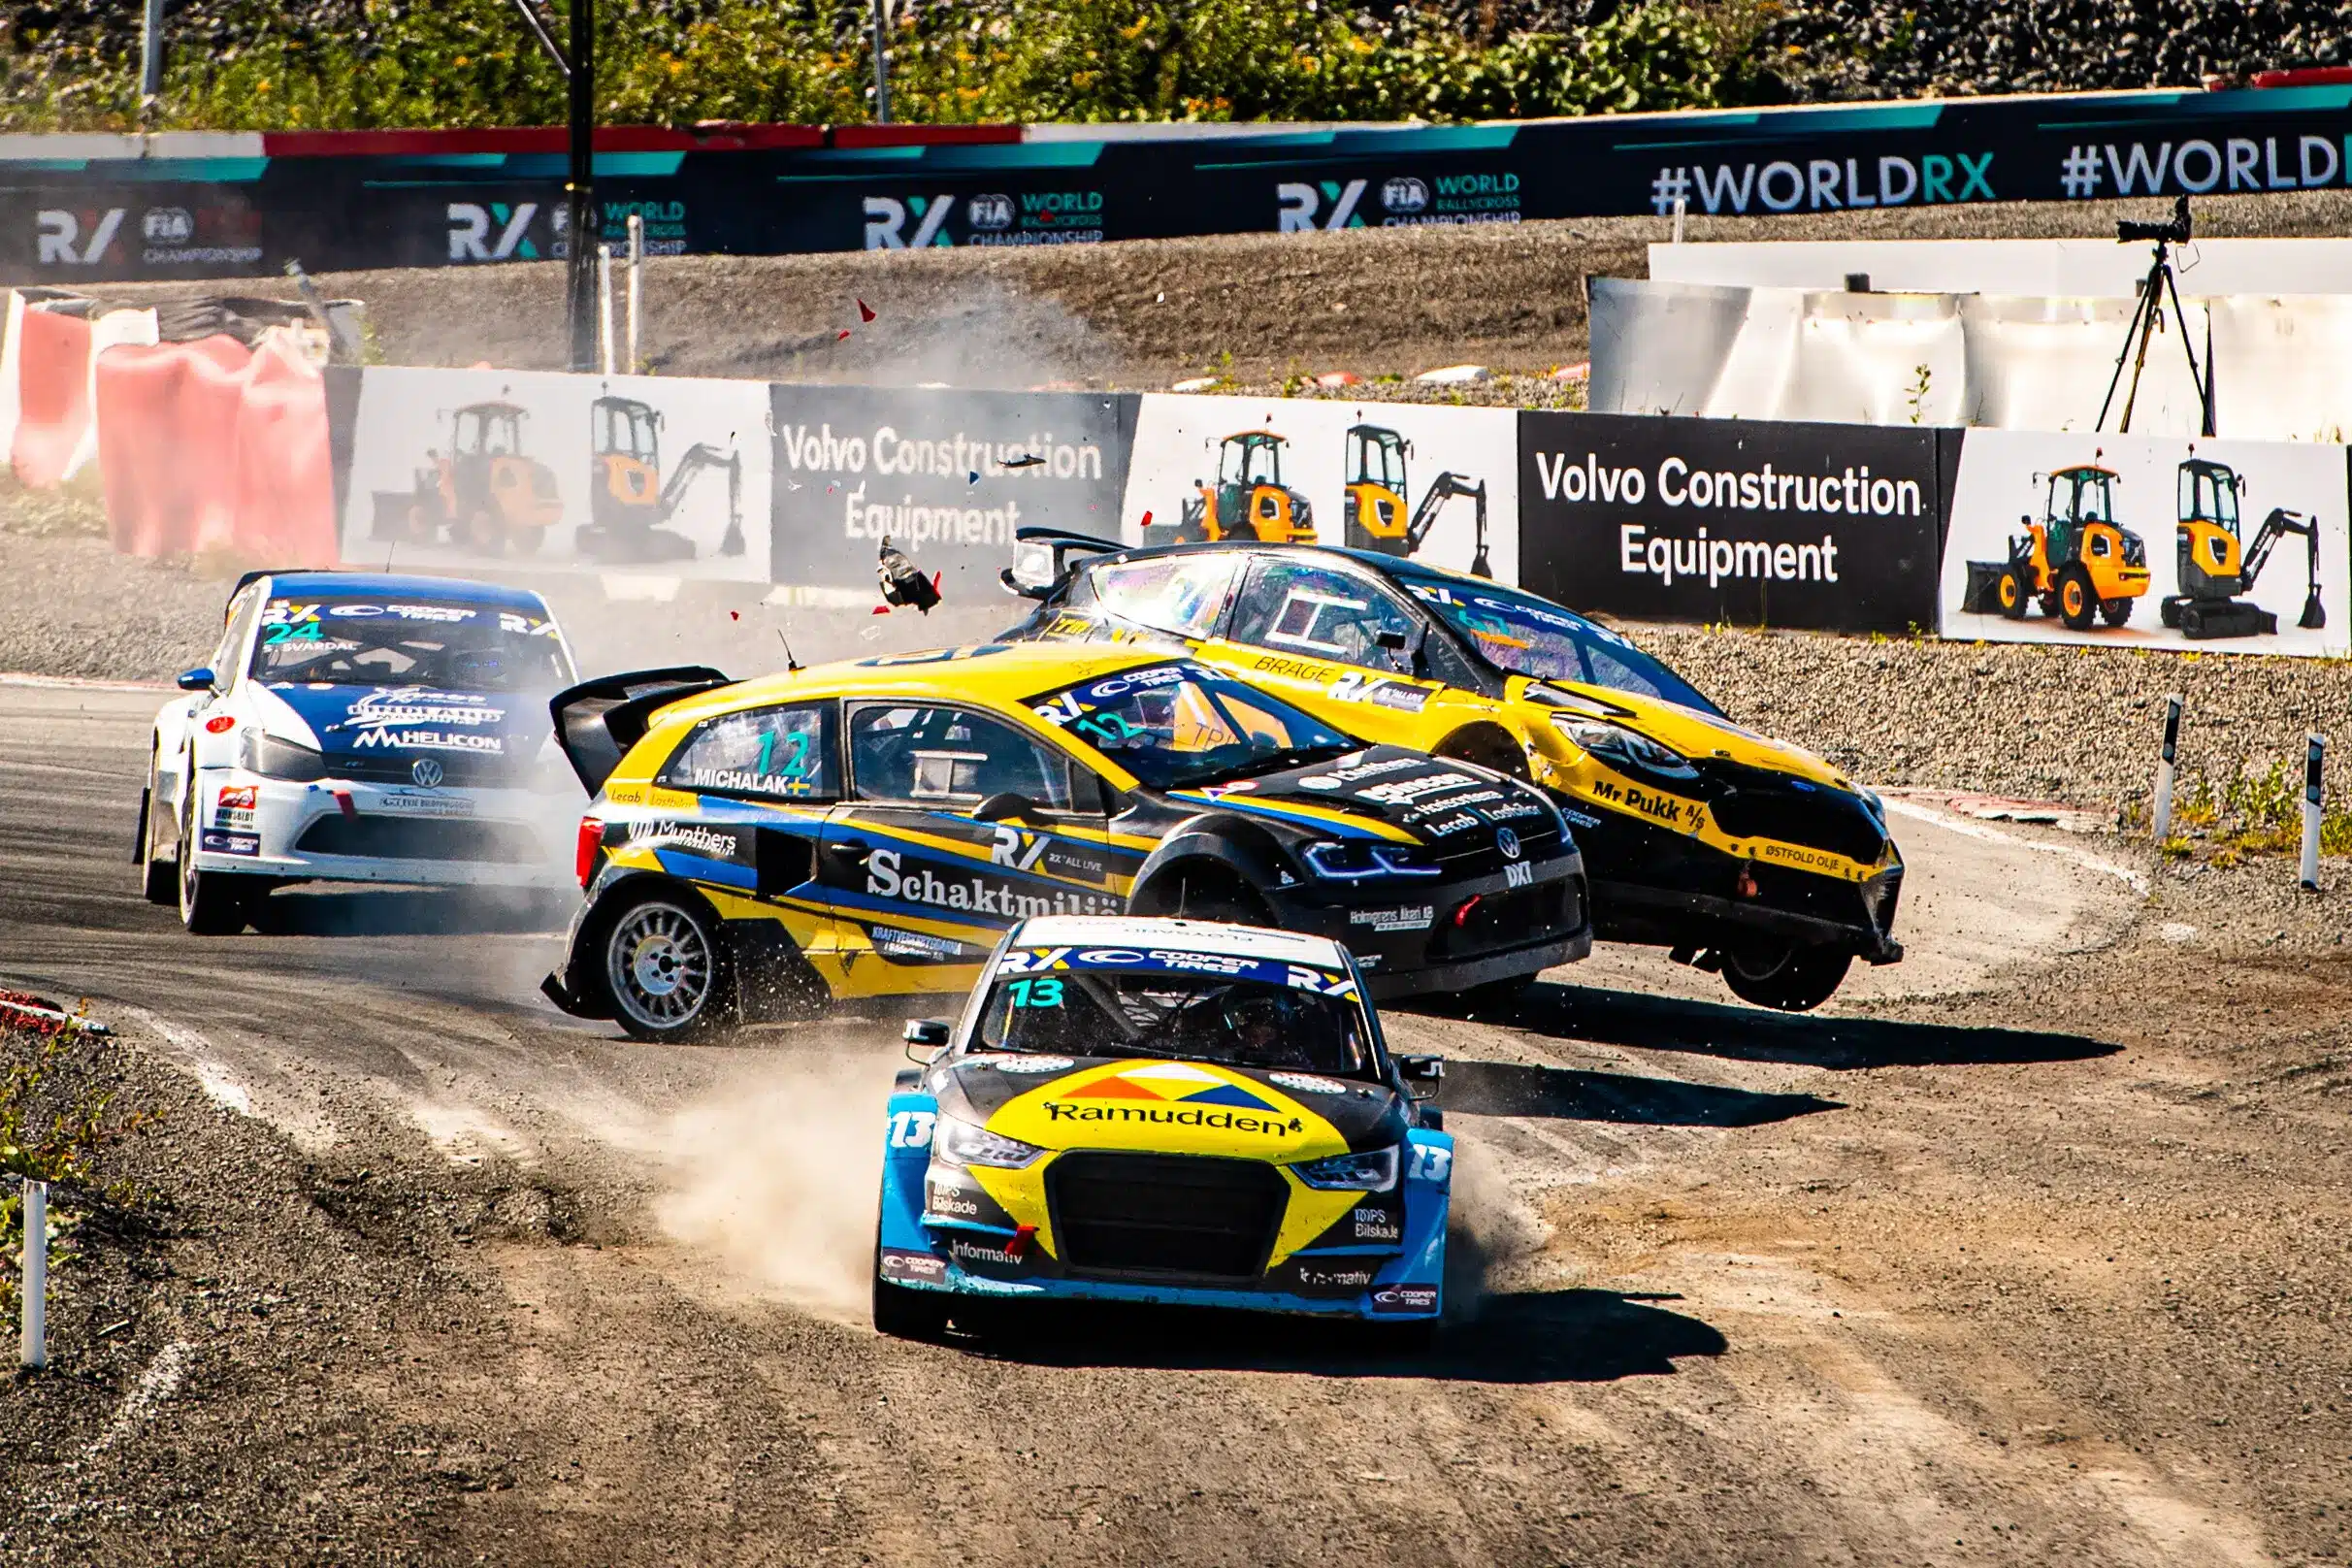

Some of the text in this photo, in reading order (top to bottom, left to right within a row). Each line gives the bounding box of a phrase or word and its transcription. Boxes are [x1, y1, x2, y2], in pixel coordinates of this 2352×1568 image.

[2061, 134, 2352, 197] #WORLD
[1436, 174, 1519, 193] WORLD
[1650, 152, 1995, 215] #WORLDRX
[603, 202, 685, 220] WORLD
[1022, 191, 1102, 211] WORLD
[1278, 179, 1368, 232] RX
[1437, 196, 1520, 210] RALLYCROSS
[448, 203, 539, 258] RX
[864, 194, 955, 248] RX
[783, 424, 1103, 480] Volvo Construction
[1536, 452, 1921, 517] Volvo Construction
[845, 489, 1021, 551] Equipment
[1620, 524, 1839, 589] Equipment
[265, 622, 324, 644] 24
[1255, 656, 1335, 683] BRAGE
[402, 730, 502, 750] HELICON
[1076, 712, 1146, 741] 12
[756, 731, 810, 776] 12
[694, 768, 788, 794] MICHALAK
[611, 788, 641, 803] Lecab
[1592, 780, 1622, 802] Mr
[1624, 787, 1682, 822] Pukk
[1424, 812, 1479, 838] Lecab
[1561, 807, 1602, 826] COOPER
[657, 819, 736, 851] Munthers
[991, 826, 1052, 873] RX
[1765, 844, 1840, 871] ØSTFOLD OLJE
[1082, 860, 1102, 872] LIVE
[1503, 860, 1533, 888] DXT
[996, 947, 1071, 975] RX
[1148, 949, 1259, 970] COOPER
[1163, 960, 1241, 974] TIRES
[1007, 978, 1064, 1009] 13
[890, 1111, 938, 1148] 13
[1049, 1102, 1289, 1138] Ramudden
[1409, 1143, 1453, 1181] 13
[1399, 1290, 1437, 1299] COOPER
[1405, 1297, 1431, 1306] TIRES
